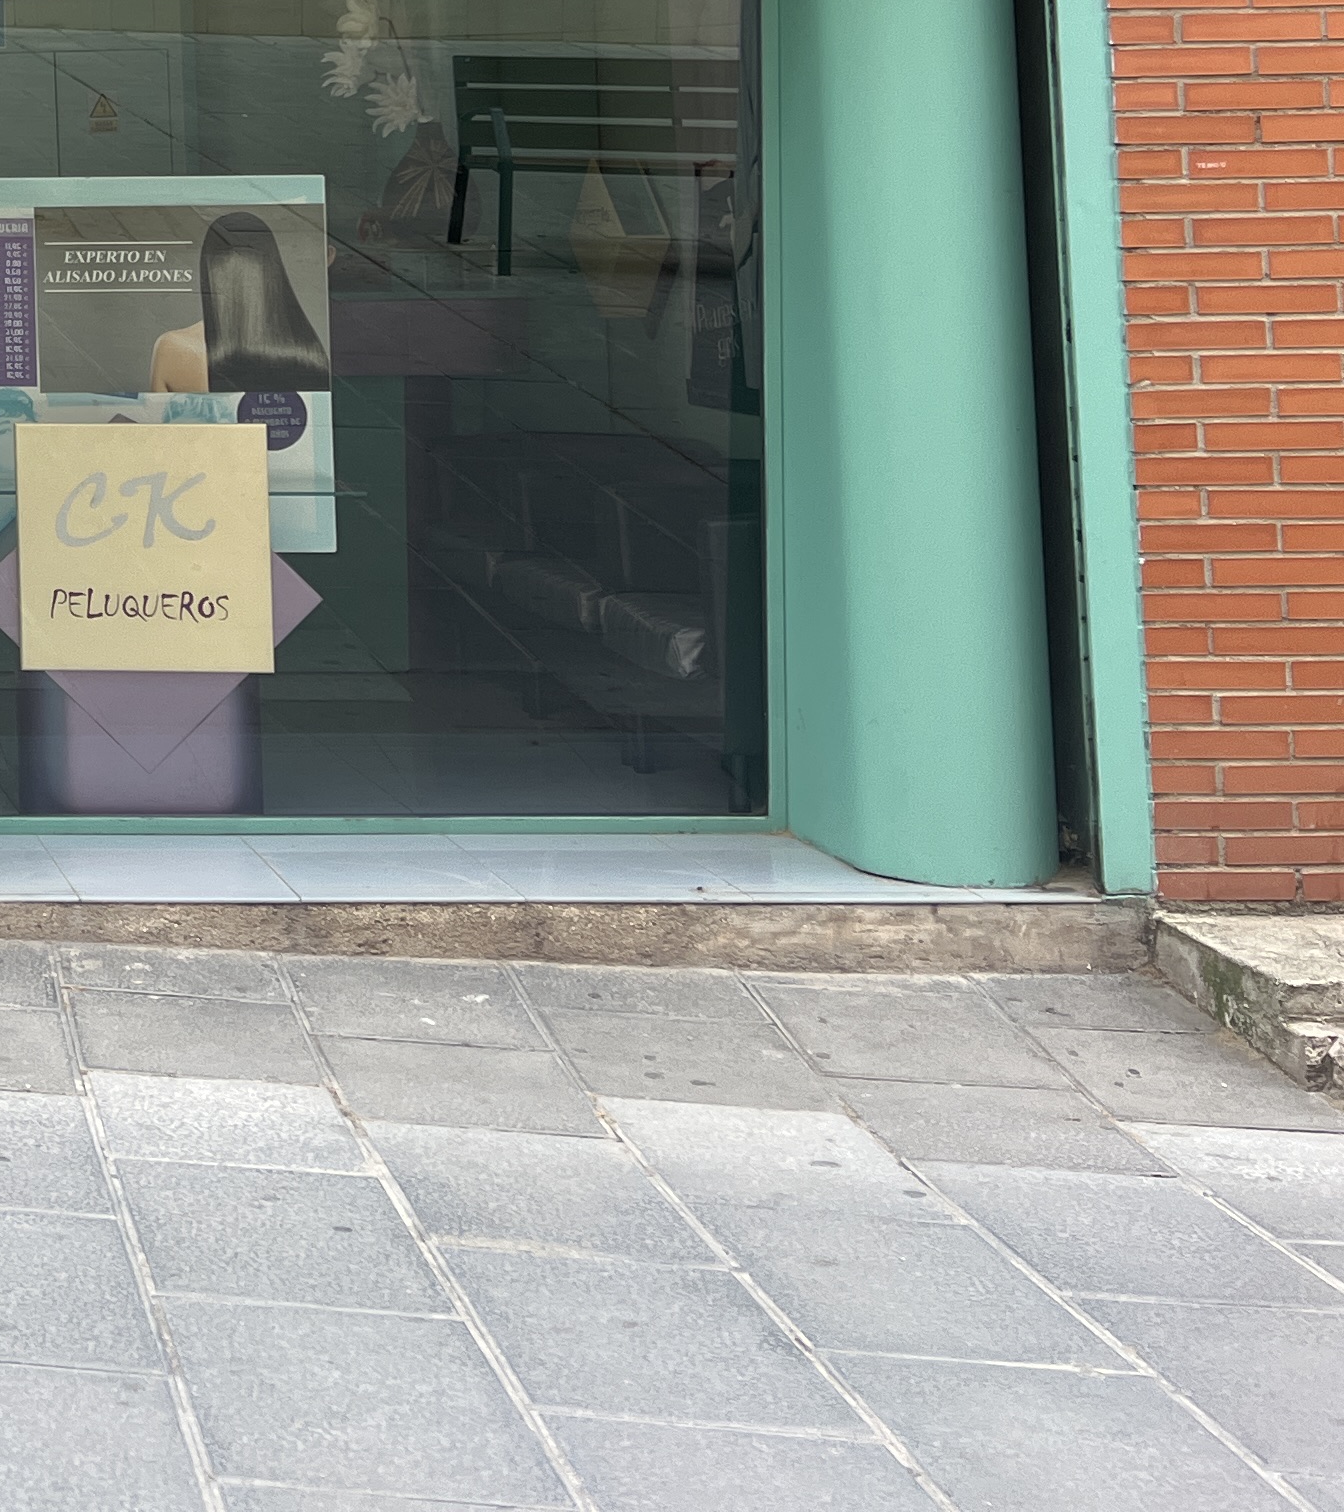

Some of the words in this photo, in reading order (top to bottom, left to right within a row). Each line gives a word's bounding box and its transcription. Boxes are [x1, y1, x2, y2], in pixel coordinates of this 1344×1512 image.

[64, 250, 140, 263] EXPERTO
[143, 250, 167, 263] EN
[43, 270, 116, 283] ALISADO
[118, 269, 193, 283] JAPONES
[55, 471, 216, 549] CK
[50, 588, 230, 623] PELUQUEROS
